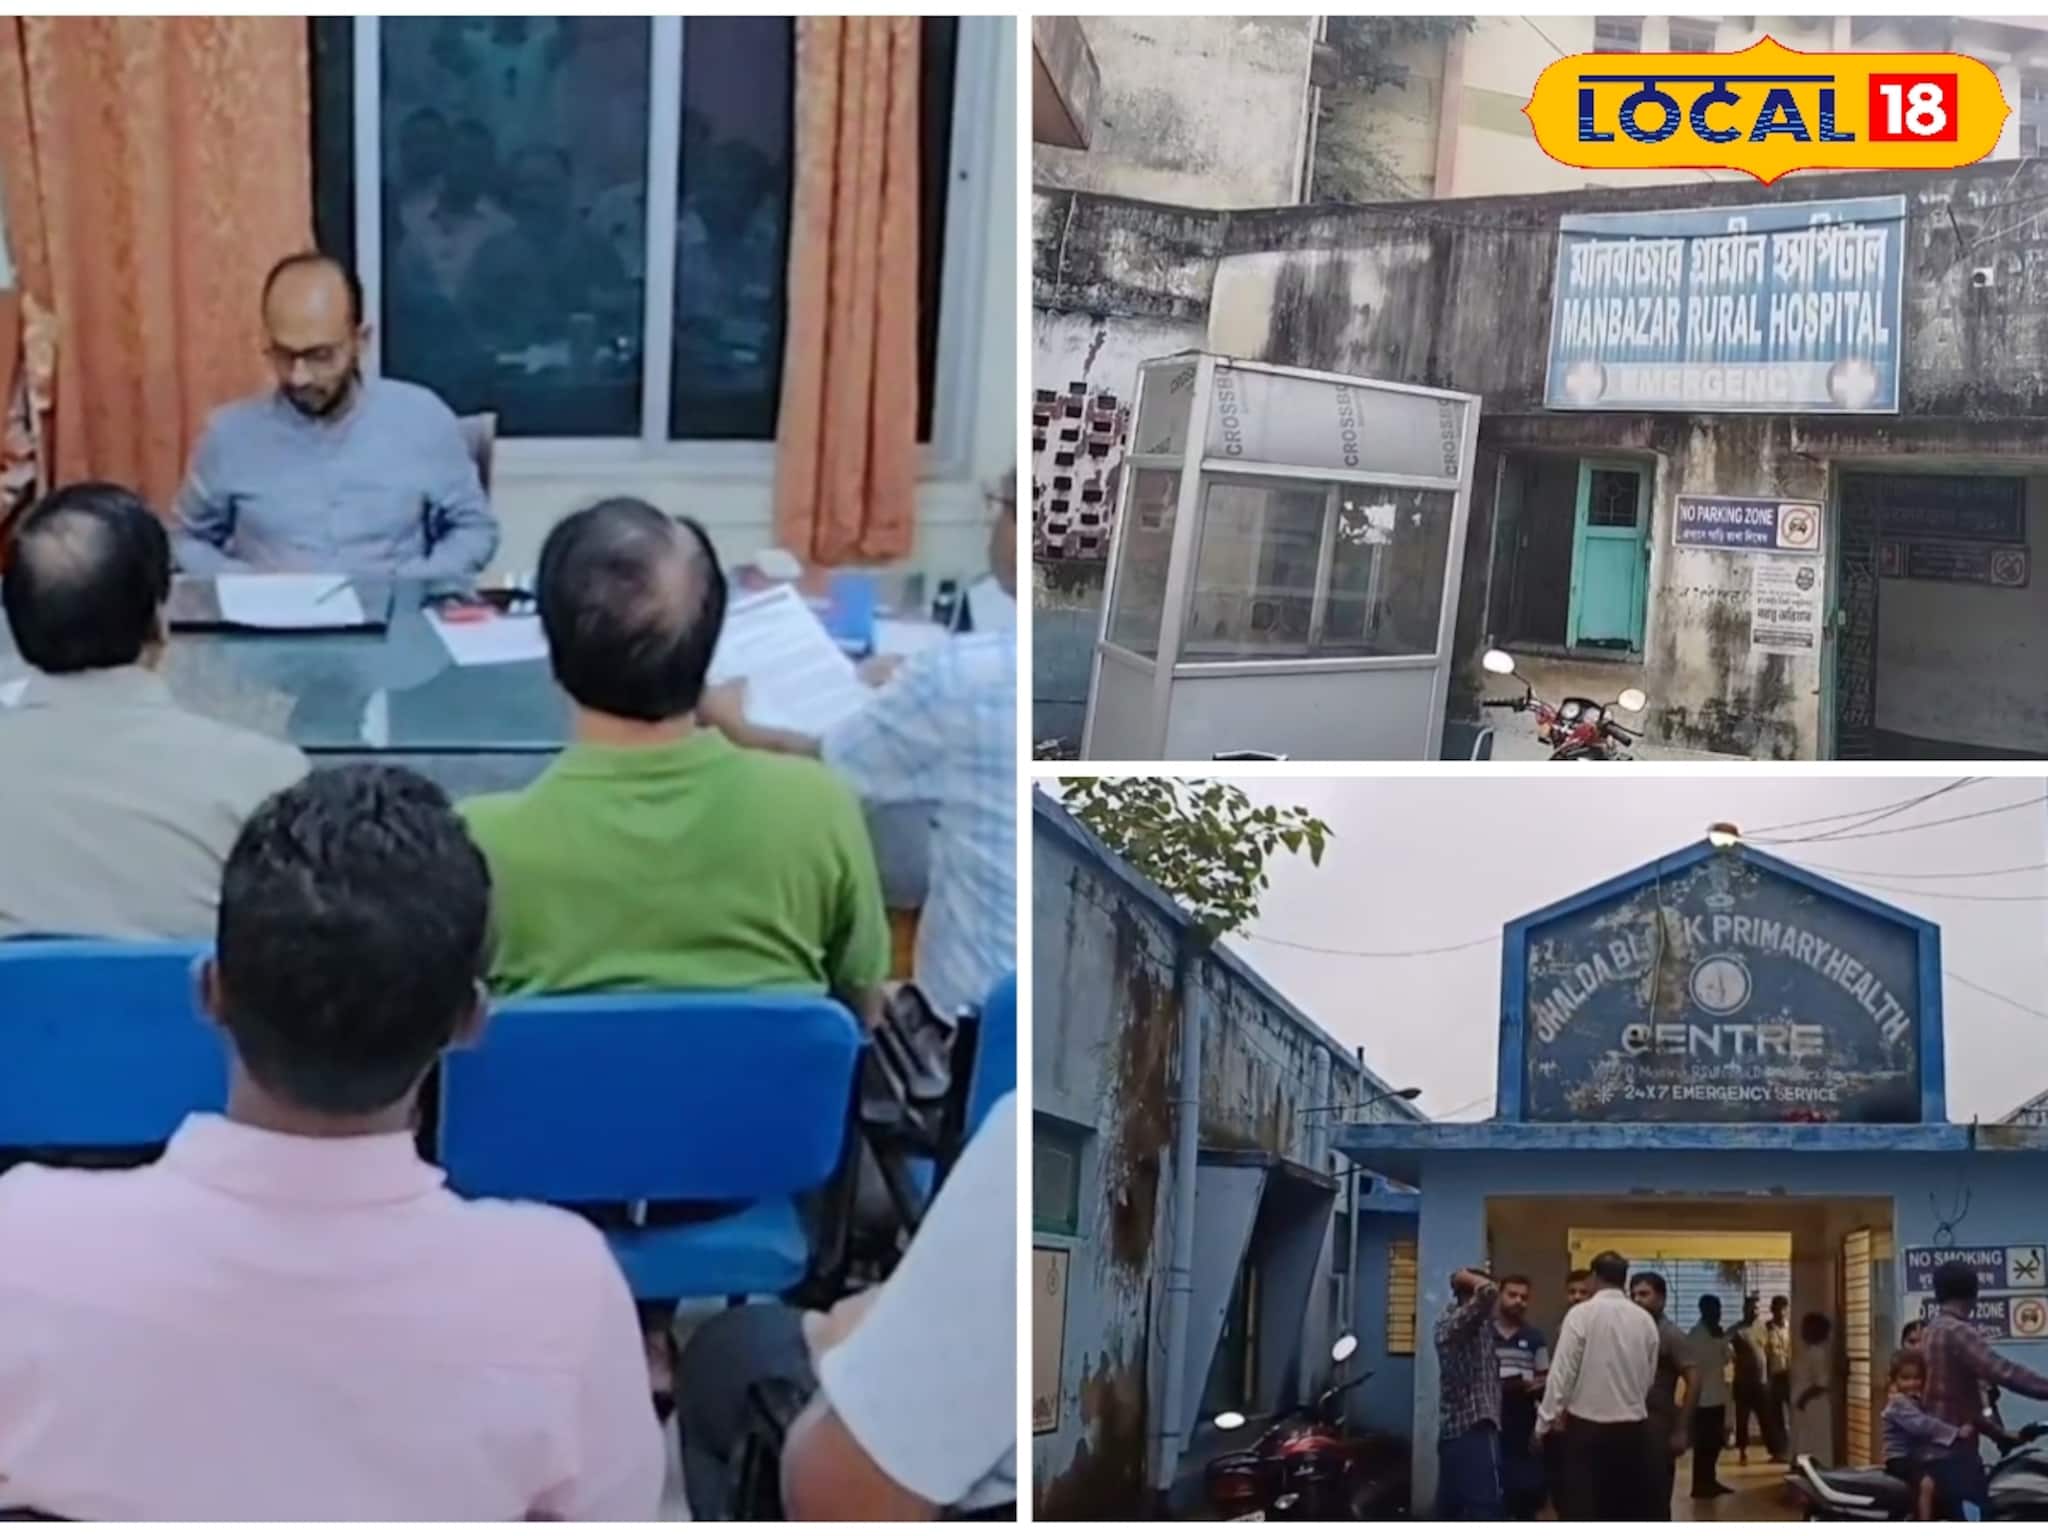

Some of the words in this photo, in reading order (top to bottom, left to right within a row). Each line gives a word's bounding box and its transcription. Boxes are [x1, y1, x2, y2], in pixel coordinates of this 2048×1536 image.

[1570, 236, 1684, 291] মানবাজার
[1560, 297, 1681, 346] MANBAZAR
[1686, 293, 1763, 345] RURAL
[1769, 290, 1890, 345] HOSPITAL
[1617, 367, 1812, 399] EMERGENCY
[1680, 504, 1696, 521] NO
[1744, 507, 1774, 526] ZONE
[1712, 914, 1831, 969] PRIMARY
[1823, 947, 1911, 1043] HEALTH
[1621, 1023, 1824, 1056] CENTRE
[1624, 1085, 1670, 1101] 24X7
[1672, 1085, 1771, 1102] EMERGENCY
[1774, 1086, 1838, 1102] SERVICE
[1908, 1251, 1931, 1267] NO
[1976, 1302, 2005, 1319] ZONE
